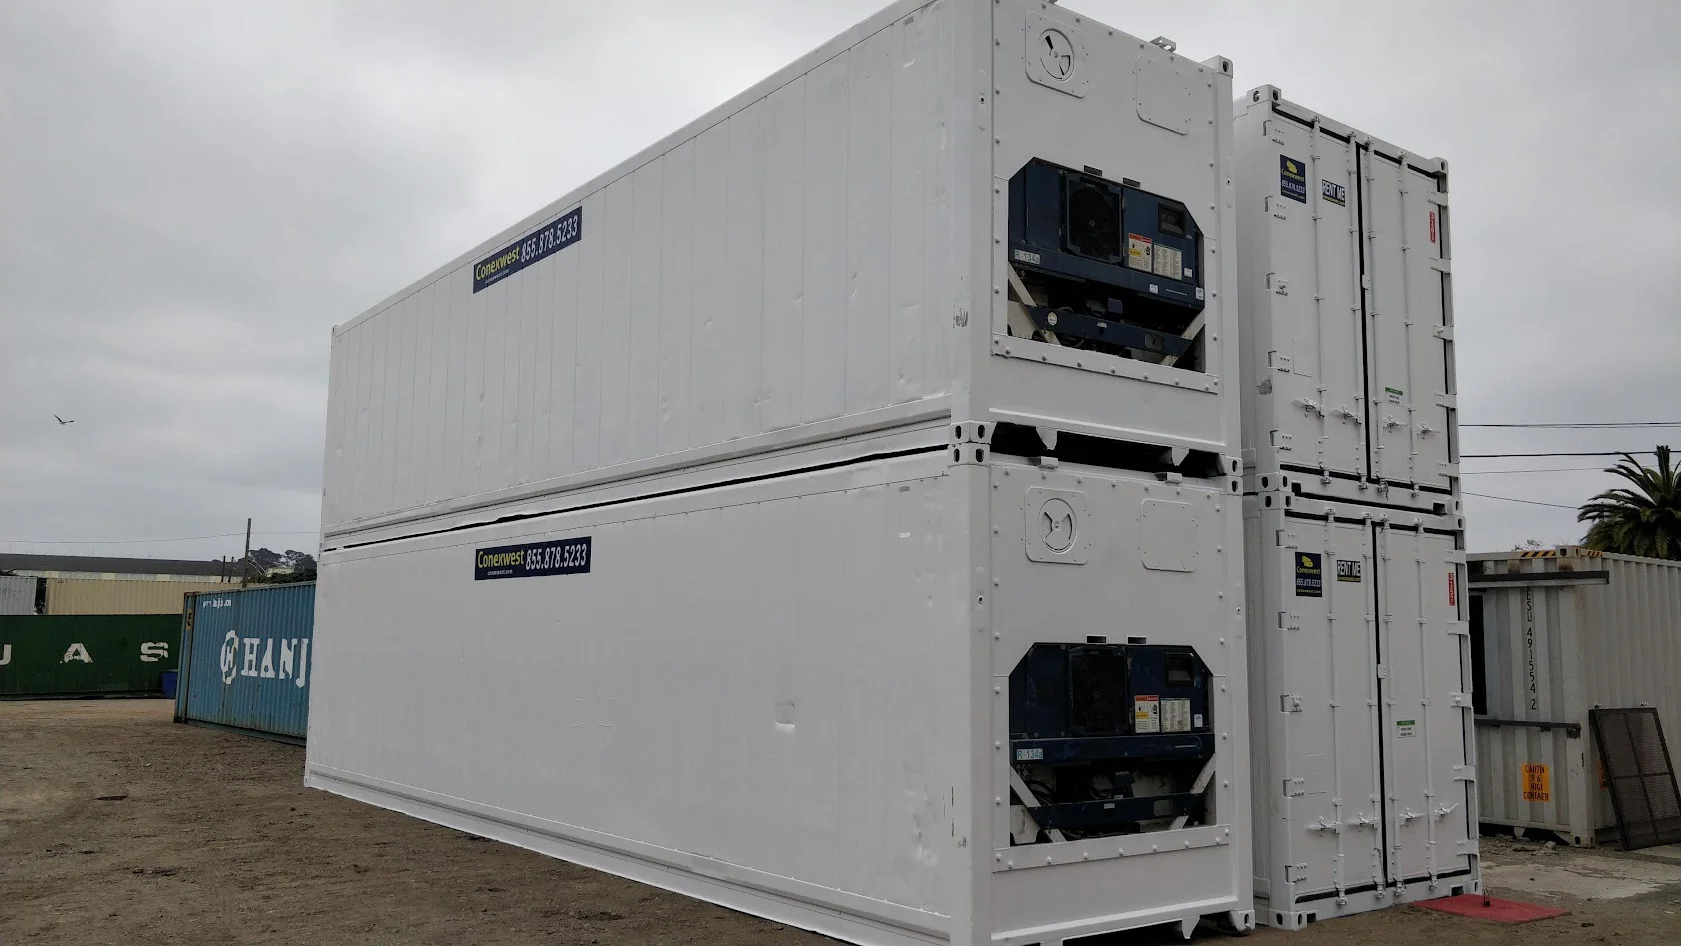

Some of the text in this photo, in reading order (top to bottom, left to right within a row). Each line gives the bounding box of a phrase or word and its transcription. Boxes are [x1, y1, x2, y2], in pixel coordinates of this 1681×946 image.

[1322, 180, 1336, 198] RENT
[1337, 185, 1345, 201] ME
[476, 215, 578, 281] Conexwest 855.878.5233
[1015, 250, 1040, 264] R-134a
[477, 544, 588, 571] Conexwest 855.878.5233
[1337, 560, 1361, 577] RENT ME
[1526, 626, 1536, 694] 491554
[1531, 698, 1537, 710] 2
